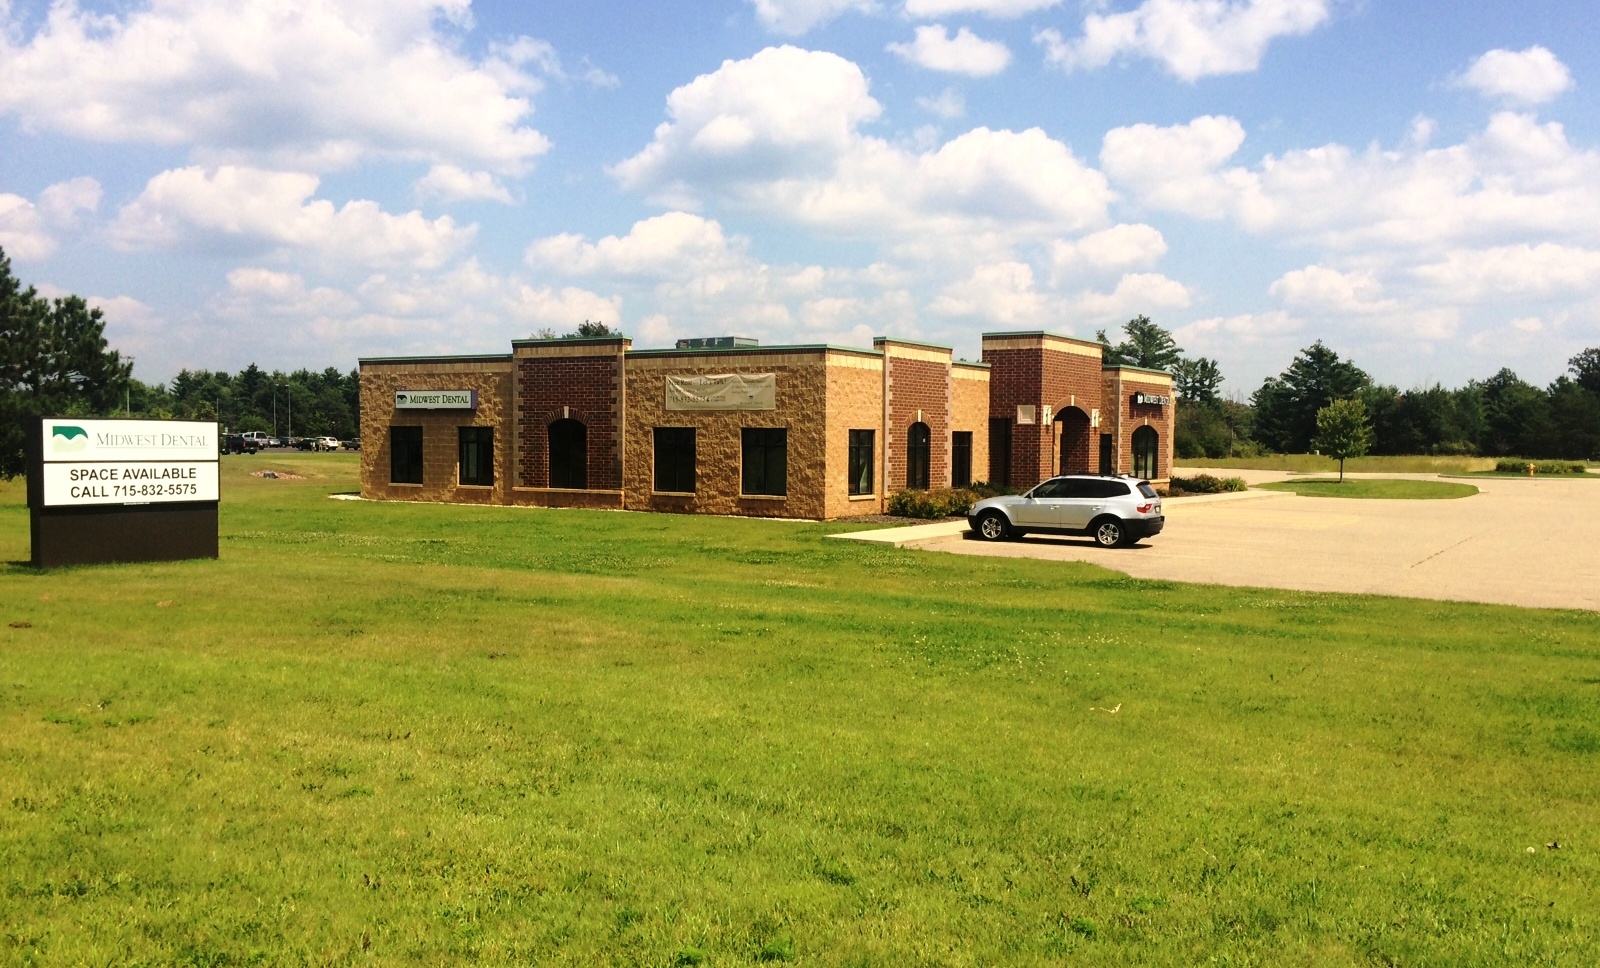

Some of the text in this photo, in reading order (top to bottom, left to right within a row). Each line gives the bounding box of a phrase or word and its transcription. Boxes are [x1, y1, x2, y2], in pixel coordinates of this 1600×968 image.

[409, 394, 468, 404] MIDWEST DENTAL
[96, 432, 209, 447] MIDWEST DENTAL
[70, 467, 197, 481] SPACE AVAILABLE
[70, 484, 197, 498] CALL 715-832-5575
